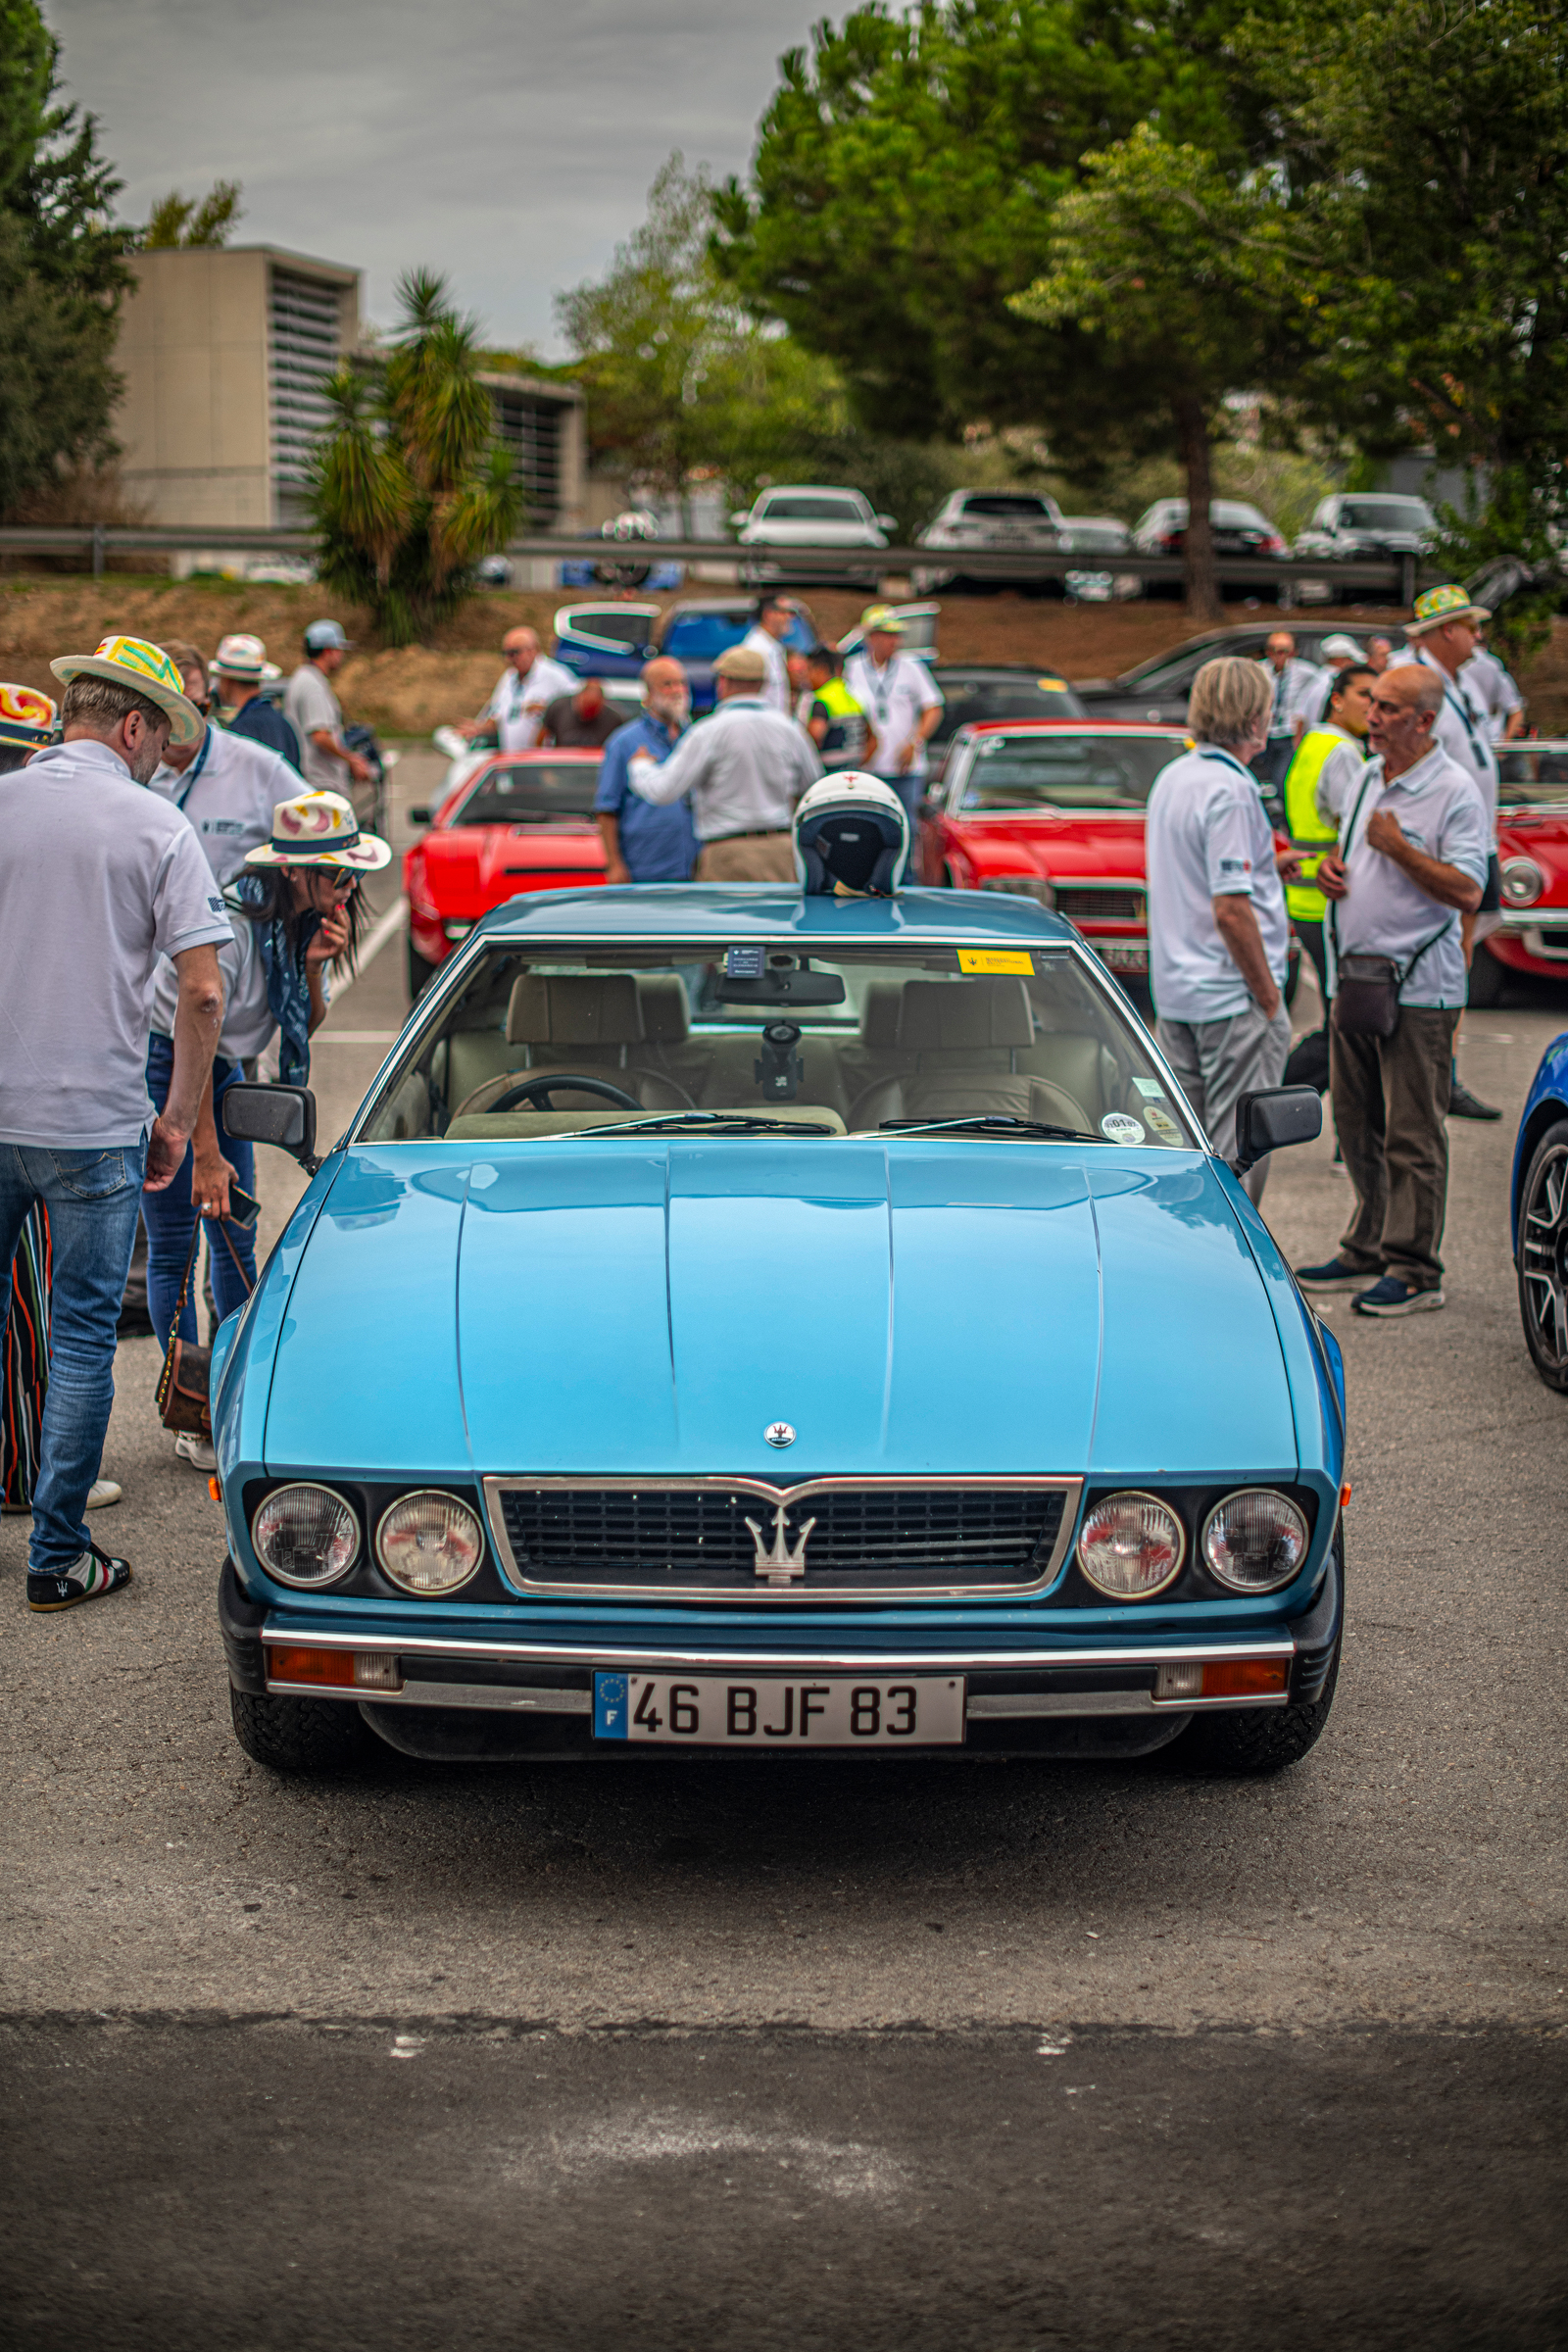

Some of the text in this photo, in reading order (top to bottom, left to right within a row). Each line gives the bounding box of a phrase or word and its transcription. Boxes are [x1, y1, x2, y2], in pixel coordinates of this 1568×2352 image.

[606, 1709, 618, 1727] F
[633, 1682, 917, 1737] 46 BJF 83
